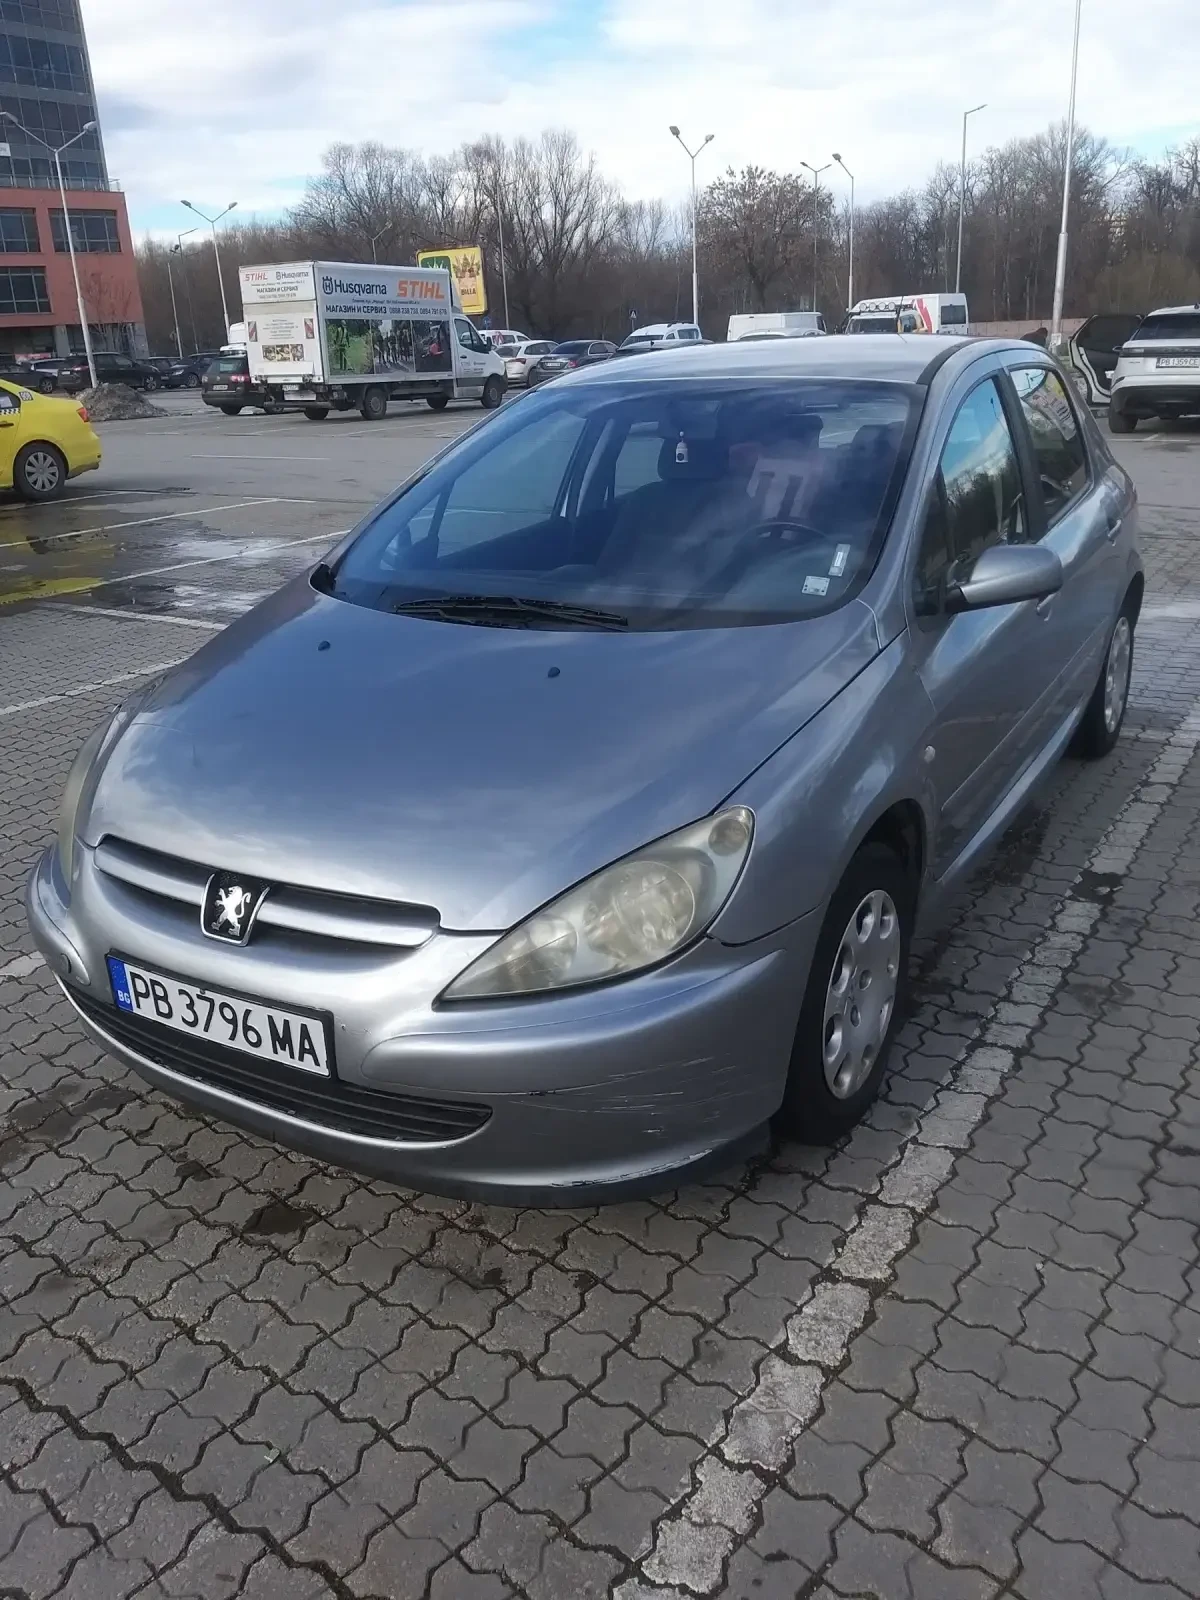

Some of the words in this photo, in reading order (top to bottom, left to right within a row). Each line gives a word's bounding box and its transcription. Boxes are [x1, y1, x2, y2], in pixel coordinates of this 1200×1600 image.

[245, 273, 268, 281] STIHL
[334, 279, 387, 296] Husqvarna
[397, 281, 445, 299] STIHL
[325, 305, 356, 313] МАГАЗИН
[357, 305, 361, 313] И
[362, 306, 387, 314] СЕРВИЗ
[117, 990, 131, 1004] BG
[129, 971, 173, 1019] PB
[178, 989, 263, 1048] 3796
[267, 1014, 321, 1067] MA
